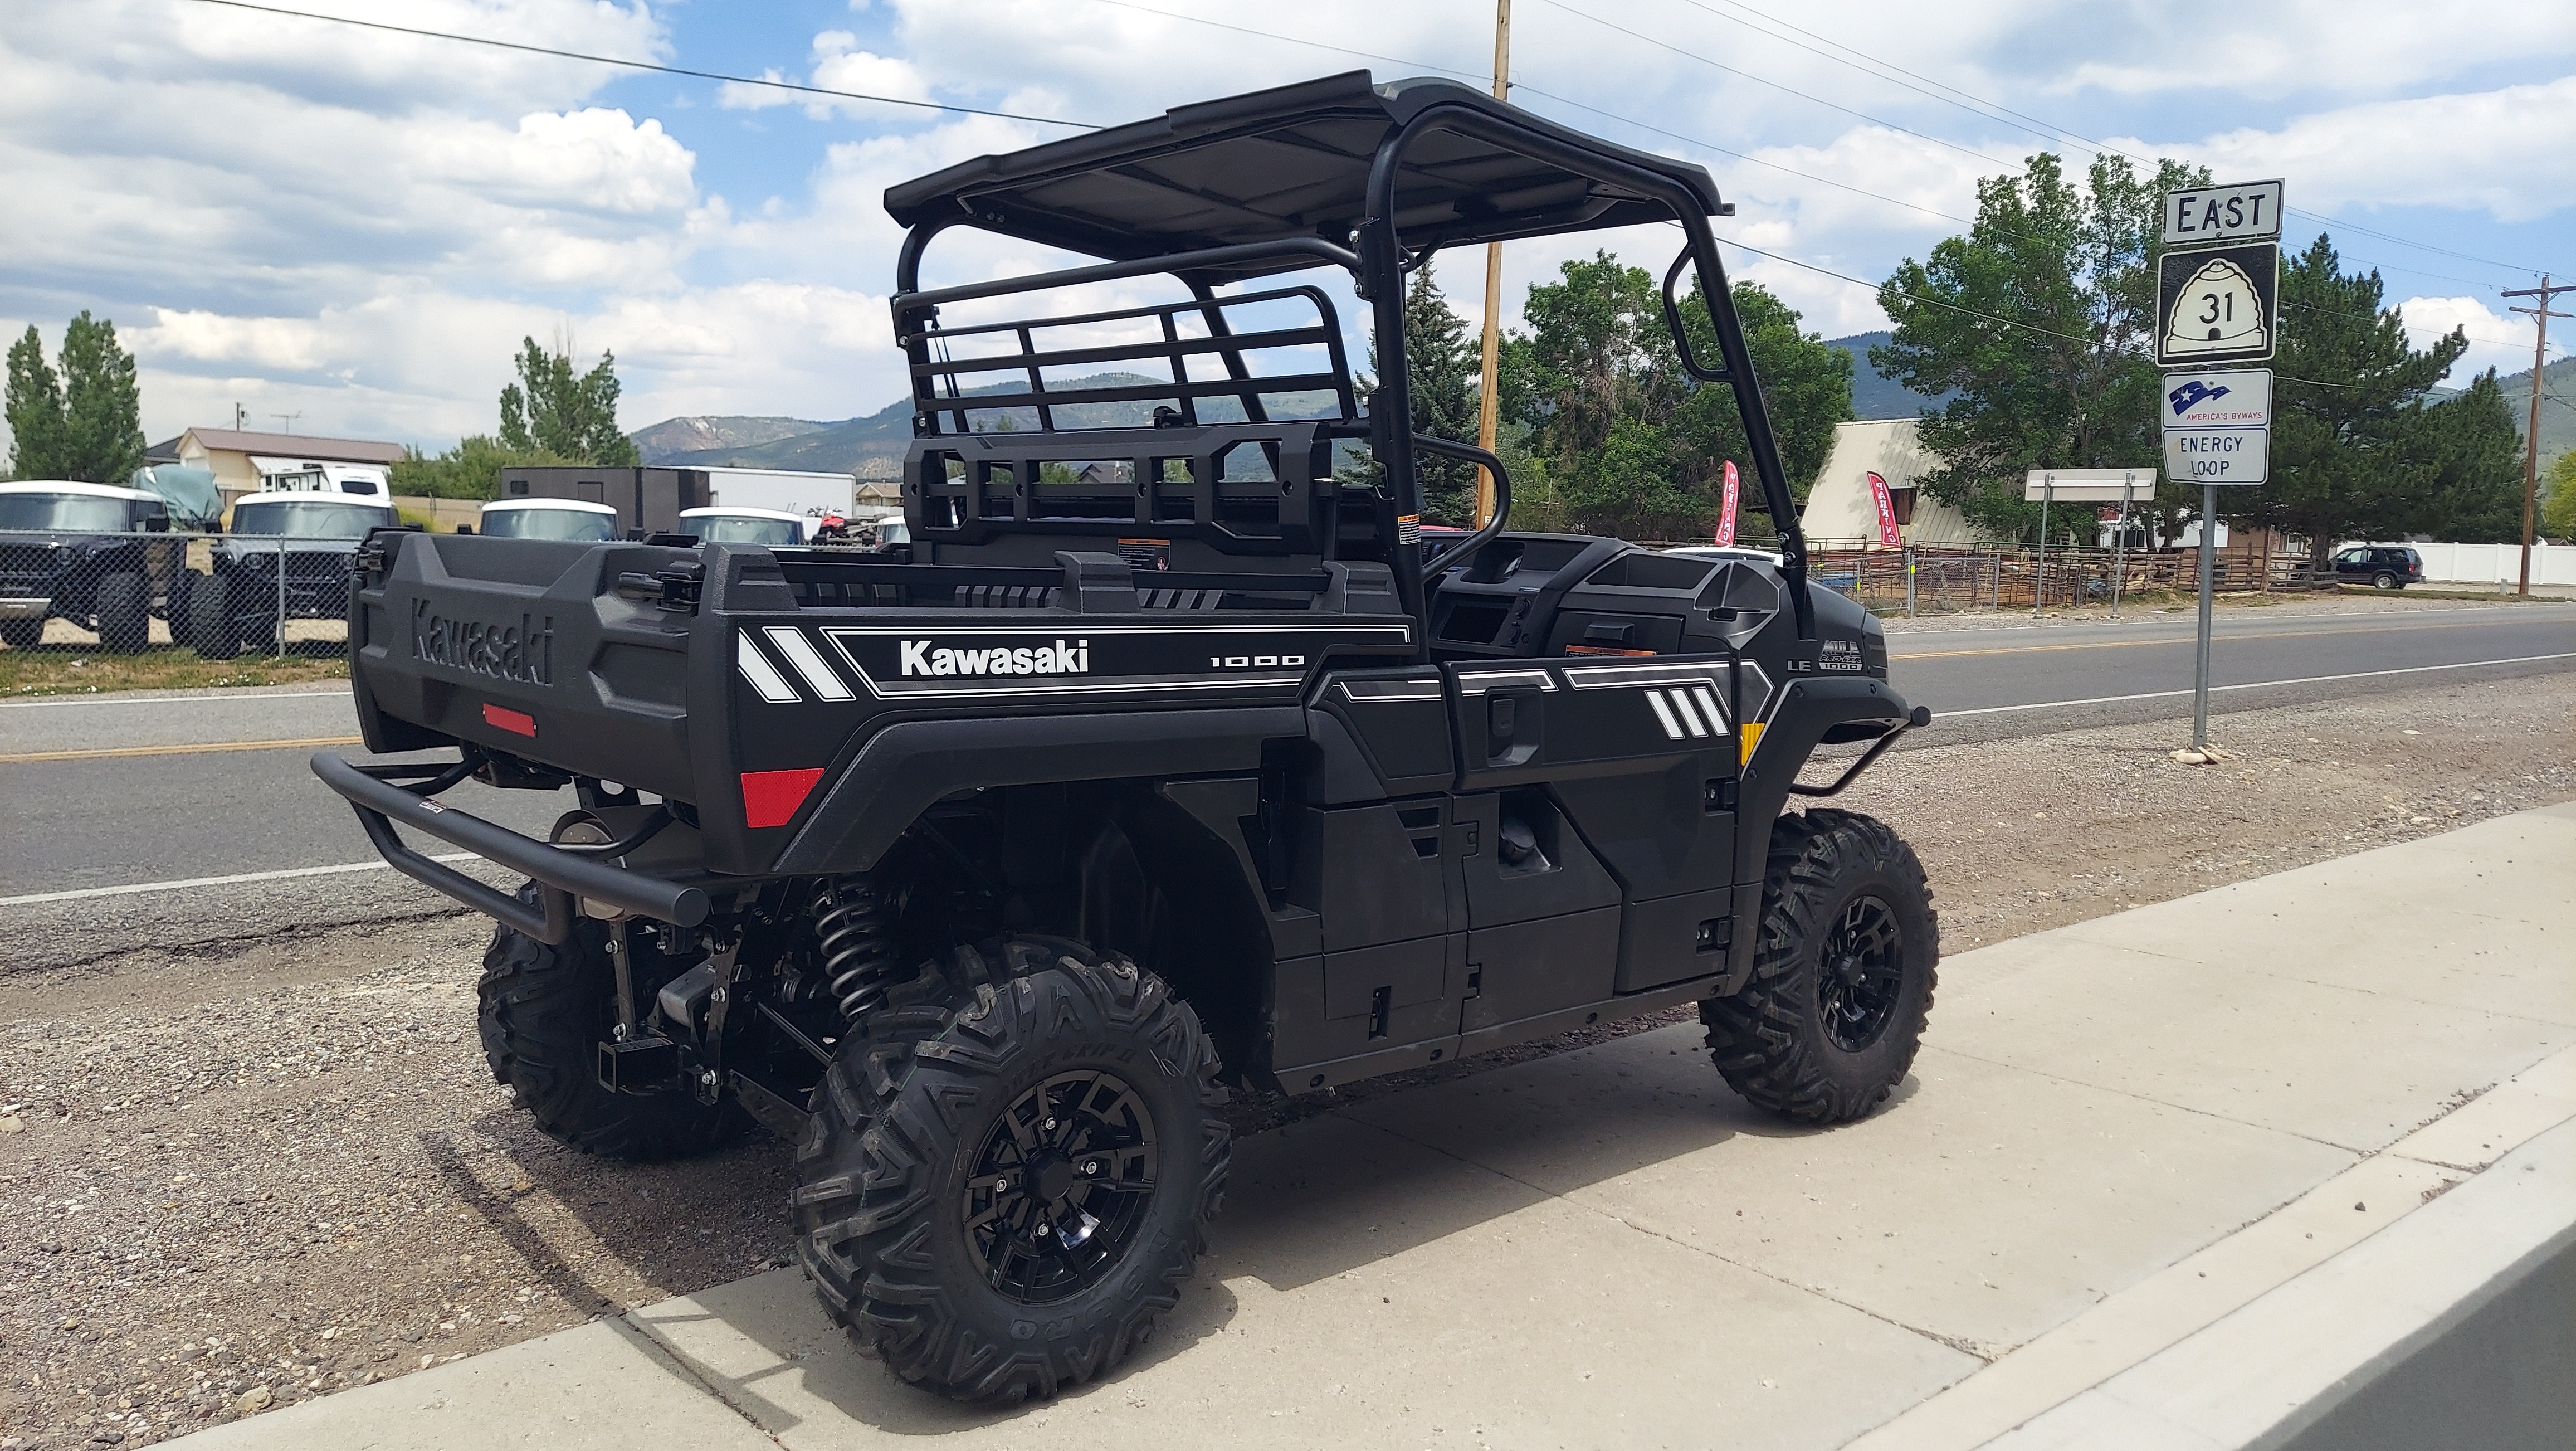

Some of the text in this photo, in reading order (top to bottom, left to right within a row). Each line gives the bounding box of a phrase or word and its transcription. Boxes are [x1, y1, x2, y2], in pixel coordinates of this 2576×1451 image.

[2178, 194, 2265, 232] EAST
[2199, 291, 2233, 324] 31
[2186, 412, 2228, 421] AMERICA'S
[2180, 436, 2243, 452] ENERGY
[2190, 460, 2229, 476] LOOP
[412, 598, 554, 687] Kawasaki
[900, 639, 1089, 676] Kawasaki
[1210, 655, 1305, 668] 1000
[1787, 660, 1811, 671] LE
